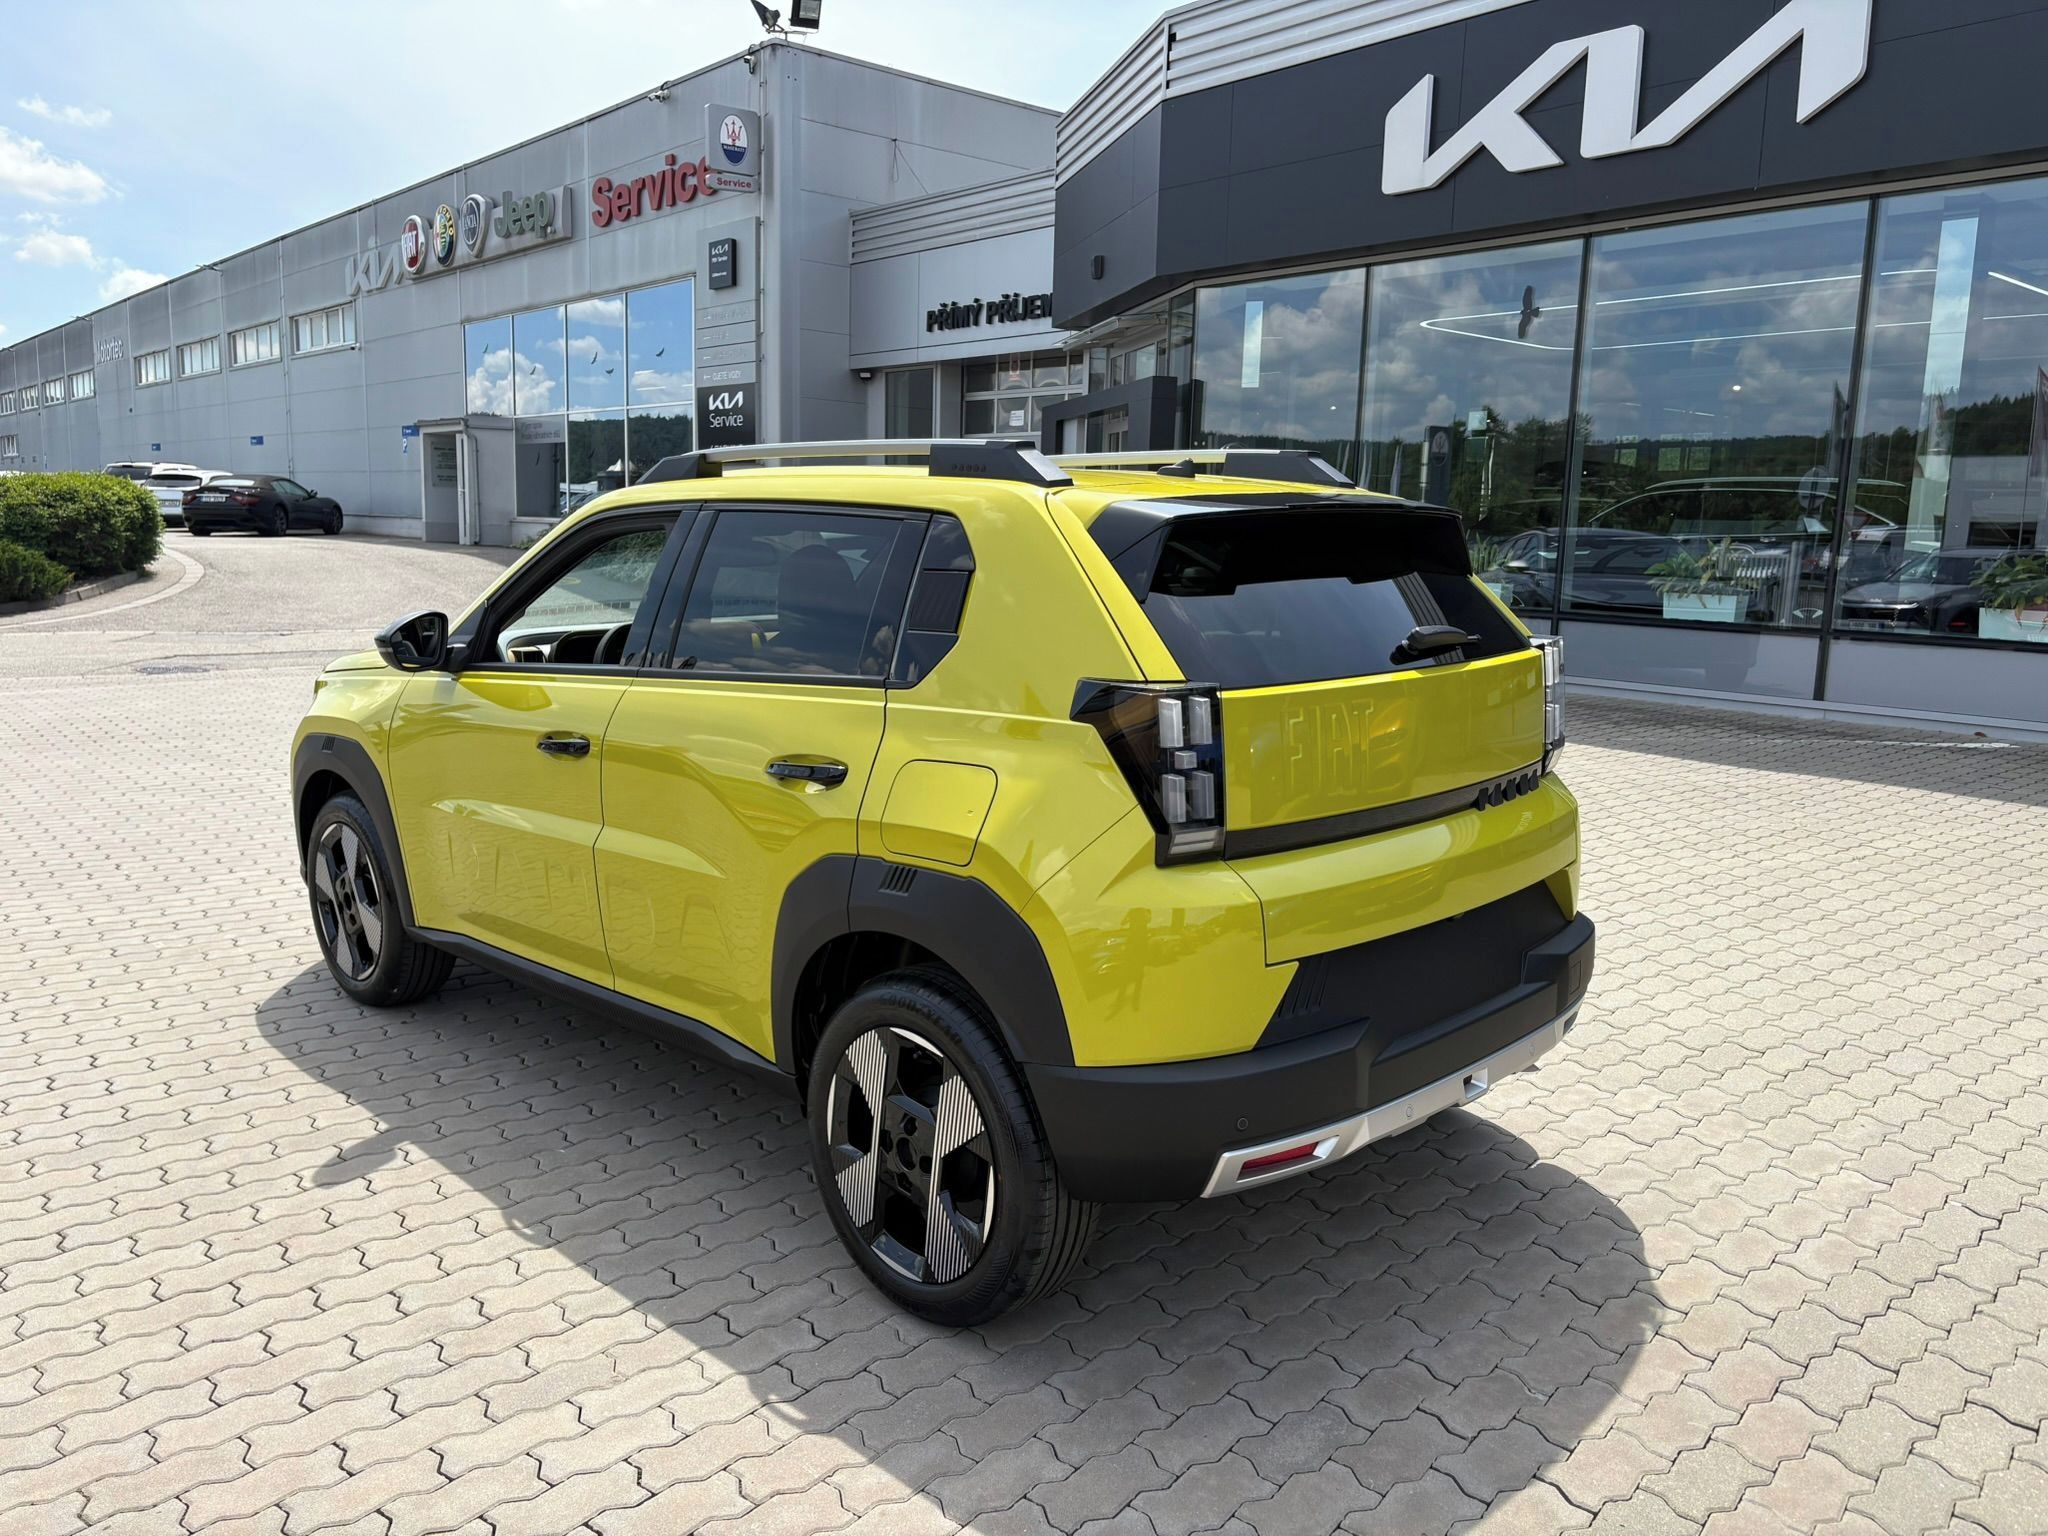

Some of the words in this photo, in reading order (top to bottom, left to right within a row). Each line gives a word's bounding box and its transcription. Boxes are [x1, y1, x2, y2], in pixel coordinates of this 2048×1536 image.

[1381, 0, 1874, 195] KIA
[716, 177, 752, 189] Service
[494, 190, 551, 239] Jeep
[401, 230, 418, 259] FIAT
[711, 243, 729, 256] KIA
[926, 297, 985, 333] PŘÍMÝ
[708, 390, 744, 411] KIA
[709, 411, 744, 428] Service
[1280, 698, 1375, 797] FIAT
